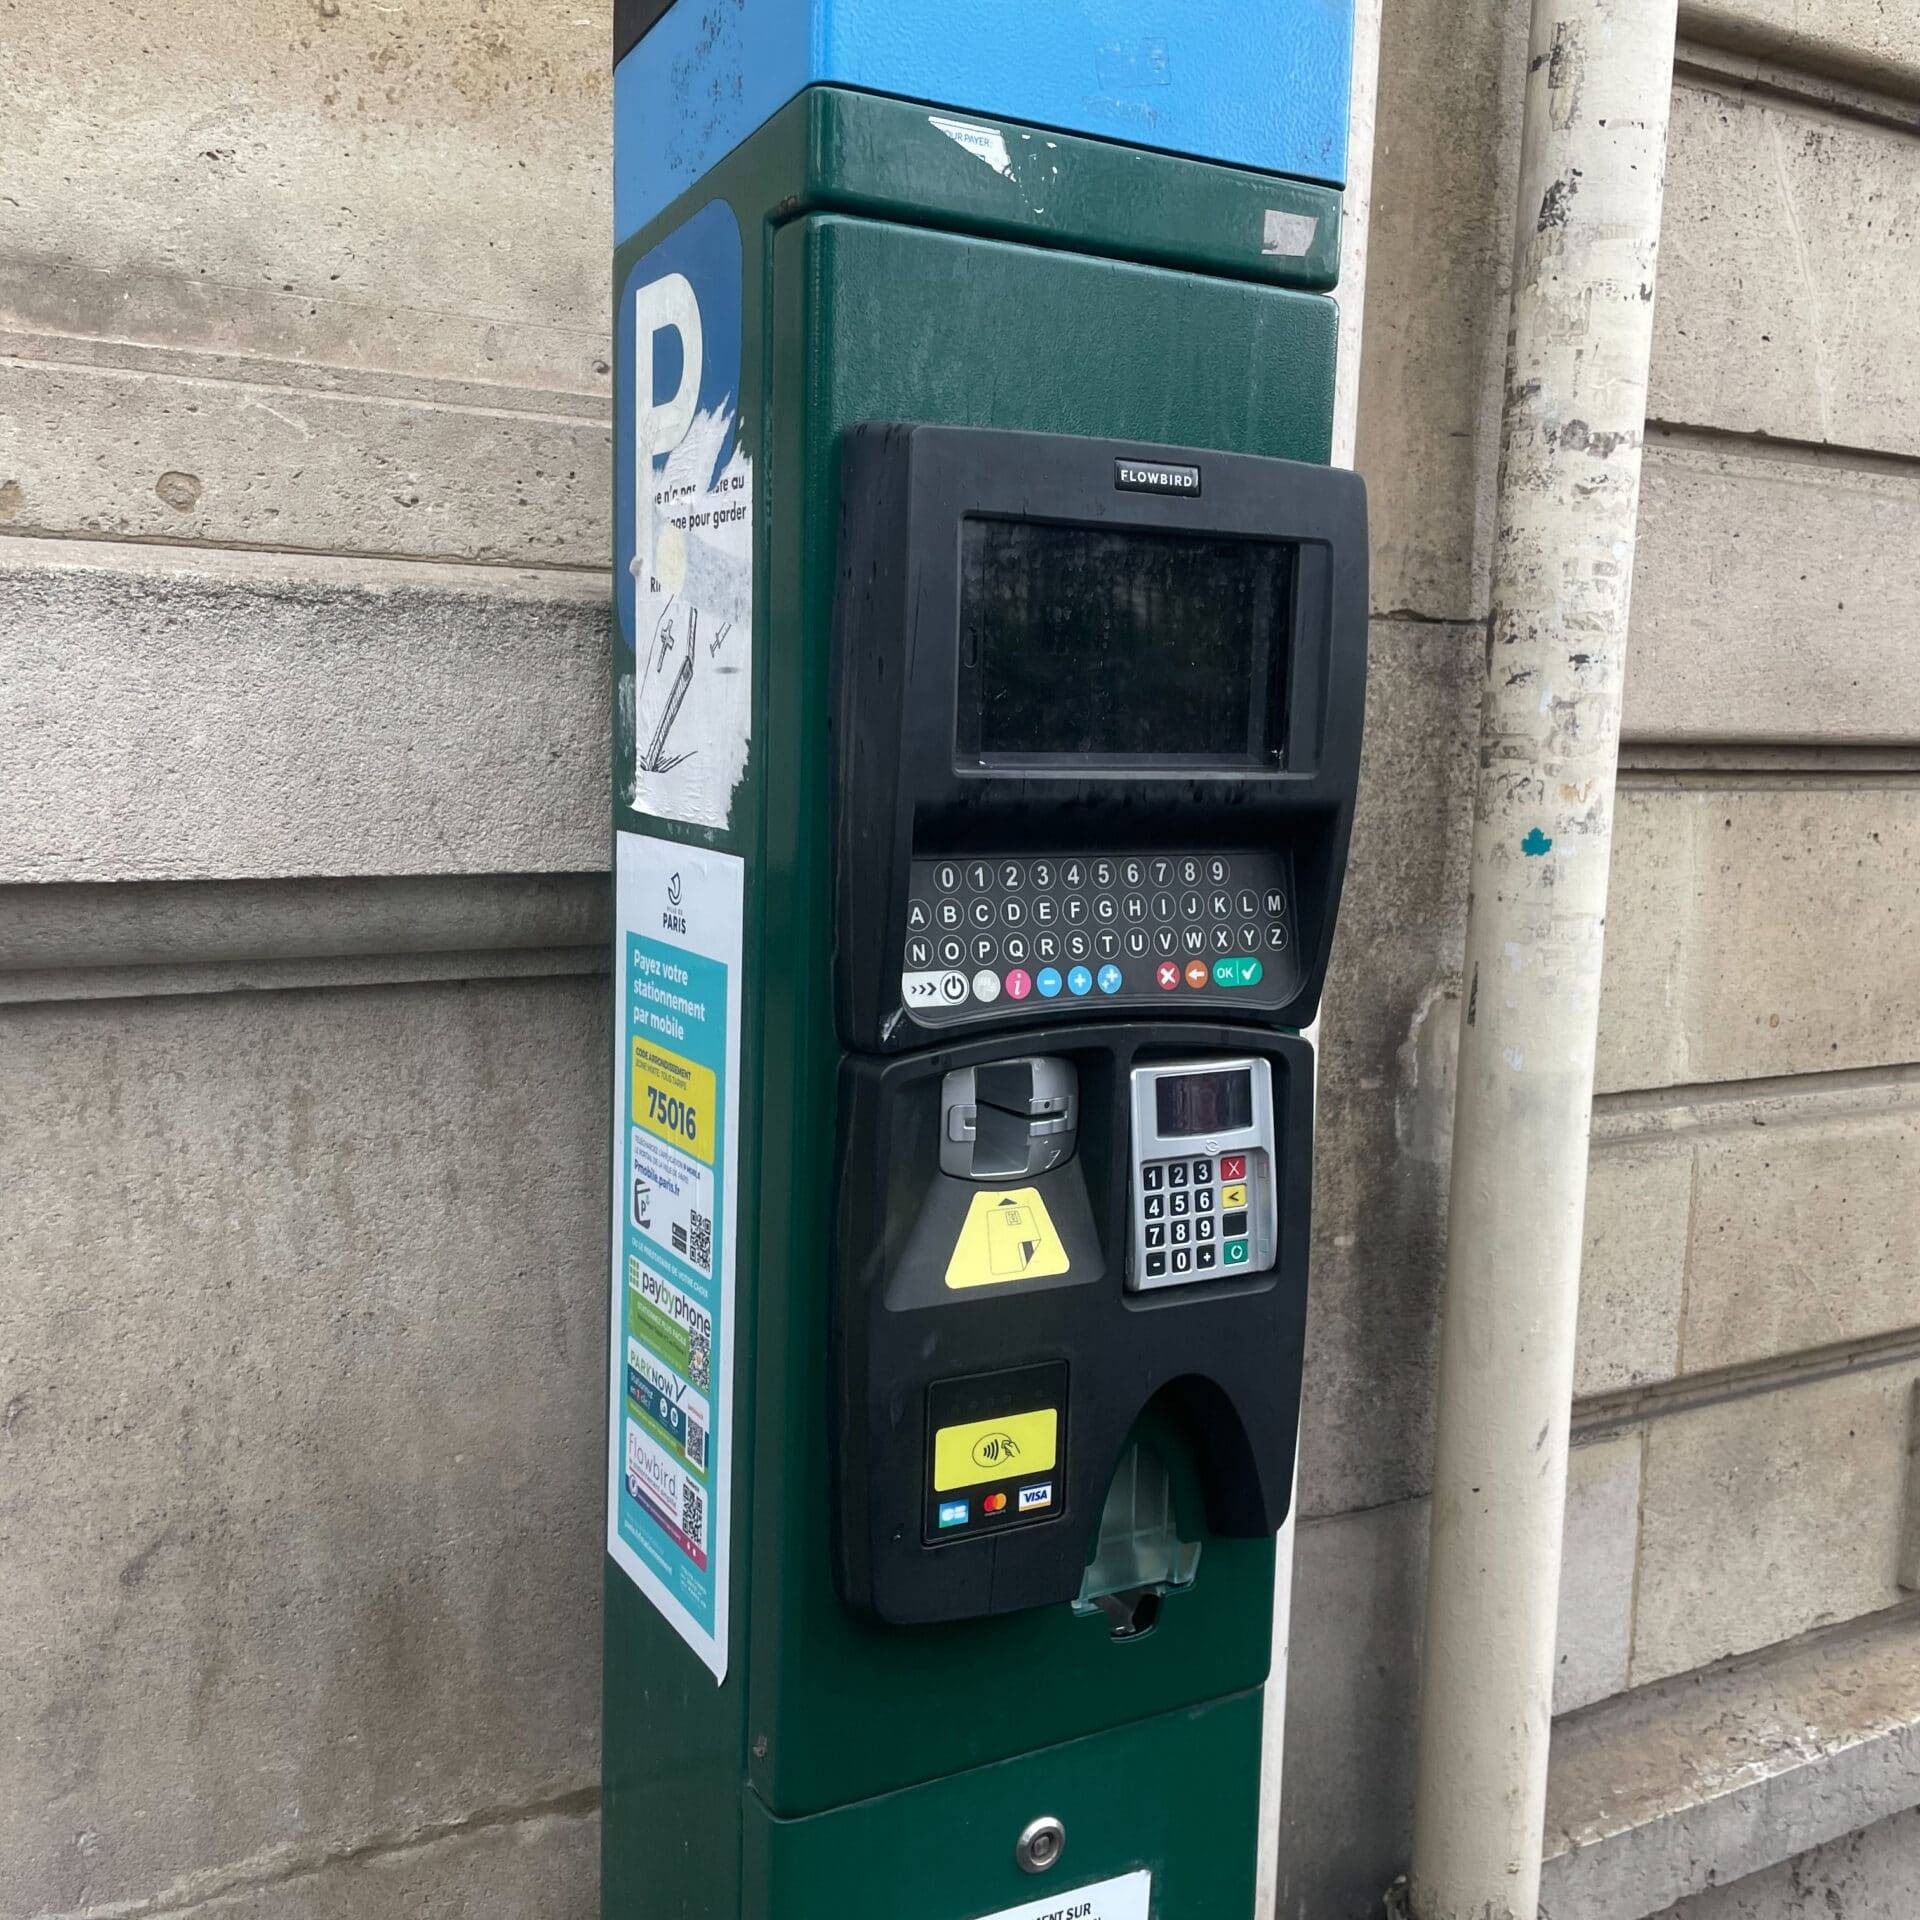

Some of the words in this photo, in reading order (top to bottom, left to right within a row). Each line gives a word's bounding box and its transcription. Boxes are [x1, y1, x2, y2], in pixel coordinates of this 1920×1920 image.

[731, 475, 745, 490] au
[1120, 469, 1193, 488] FLOWBIRD
[689, 512, 711, 532] pour
[713, 501, 747, 530] garder
[941, 867, 954, 888] 0
[973, 867, 985, 887] 1
[1006, 866, 1019, 886] 2
[1037, 865, 1049, 886] 3
[1067, 864, 1080, 885] 4
[1098, 864, 1110, 884] 5
[1127, 863, 1139, 883] 6
[1155, 862, 1167, 882] 7
[1185, 862, 1196, 882] 8
[1212, 861, 1223, 881] 9
[910, 906, 925, 924] A
[943, 905, 957, 923] B
[975, 904, 989, 922] C
[1007, 903, 1021, 921] D
[1039, 902, 1052, 920] E
[1070, 901, 1081, 918] F
[1099, 900, 1113, 917] G
[1129, 899, 1141, 916] H
[1186, 897, 1196, 914] J
[1214, 897, 1227, 913] K
[1243, 896, 1253, 912] L
[1267, 895, 1281, 911] M
[663, 912, 687, 935] PARIS
[912, 943, 926, 962] N
[944, 942, 960, 960] O
[978, 941, 991, 959] P
[1009, 939, 1024, 958] Q
[1041, 938, 1055, 956] R
[1072, 937, 1084, 954] S
[1101, 935, 1113, 953] T
[1131, 934, 1143, 951] U
[1159, 933, 1172, 950] V
[1185, 932, 1203, 949] W
[1216, 930, 1228, 948] X
[1243, 929, 1255, 946] Y
[1271, 928, 1282, 945] Z
[633, 949, 661, 977] Payez
[663, 963, 689, 987] votre
[1215, 967, 1234, 979] OK
[633, 979, 706, 1022] stationnement
[633, 1005, 649, 1025] par
[650, 1013, 685, 1041] mobile
[647, 1085, 697, 1141] 75016
[1148, 1170, 1156, 1187] 1
[1174, 1167, 1184, 1185] 2
[1198, 1163, 1208, 1181] 3
[1149, 1198, 1160, 1216] 4
[1175, 1195, 1185, 1213] 5
[1199, 1191, 1210, 1209] 6
[1149, 1227, 1160, 1245] 7
[1176, 1223, 1186, 1241] 8
[1200, 1219, 1211, 1237] 9
[1176, 1251, 1187, 1270] 0
[642, 1271, 711, 1338] paybyphone
[629, 1432, 677, 1497] Flowbird
[1023, 1489, 1049, 1503] VISA
[1066, 1902, 1091, 1920] SUR
